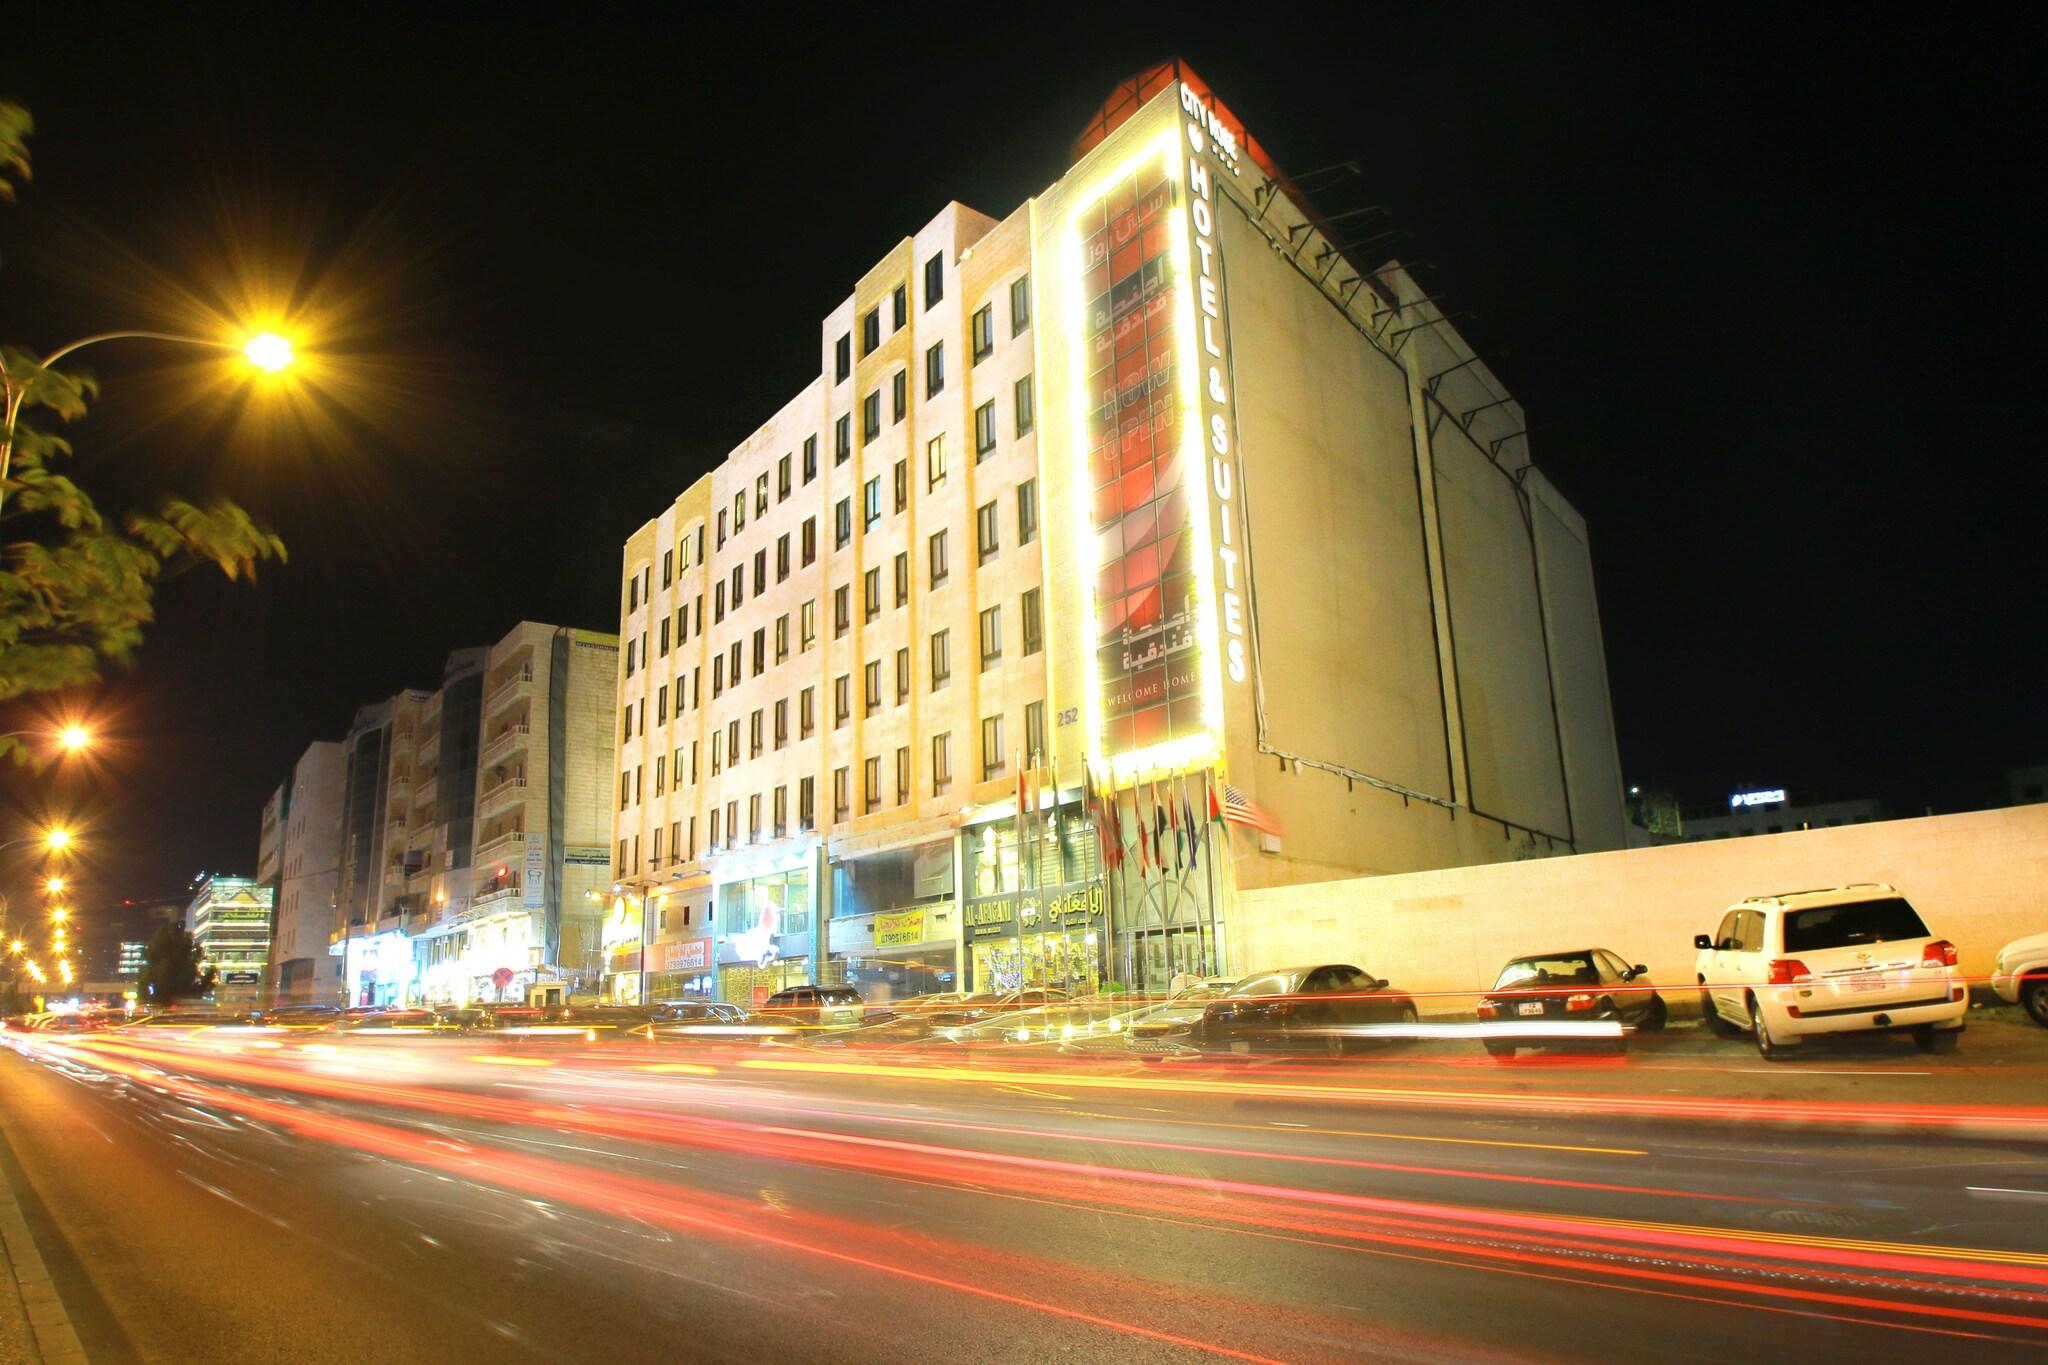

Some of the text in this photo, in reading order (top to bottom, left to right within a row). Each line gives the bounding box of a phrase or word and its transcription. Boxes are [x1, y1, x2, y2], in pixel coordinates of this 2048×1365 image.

[1180, 82, 1206, 128] CITY
[1189, 156, 1246, 683] HOTEL & SUITES
[1107, 683, 1159, 707] WELCOME
[1057, 707, 1079, 727] 252
